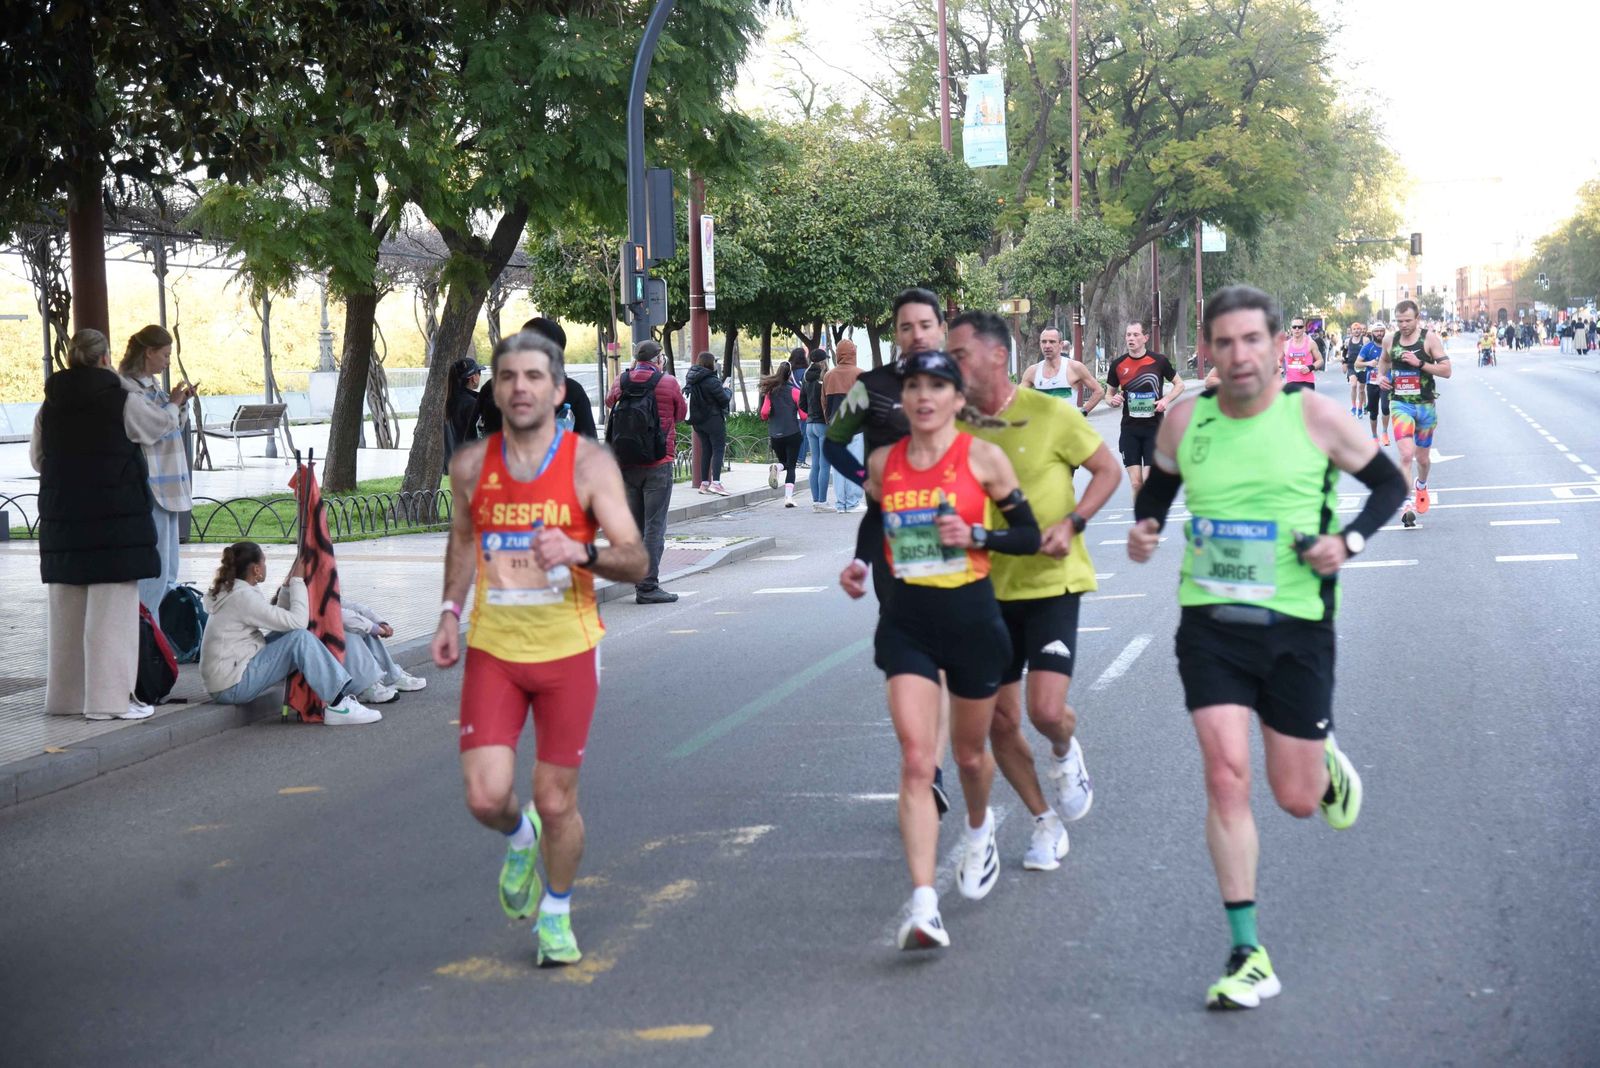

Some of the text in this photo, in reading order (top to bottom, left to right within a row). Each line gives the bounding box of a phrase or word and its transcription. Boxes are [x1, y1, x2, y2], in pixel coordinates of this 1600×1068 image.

[492, 499, 571, 526] SESEÑA
[1218, 523, 1268, 537] ZURICH
[1208, 562, 1256, 581] JORGE
